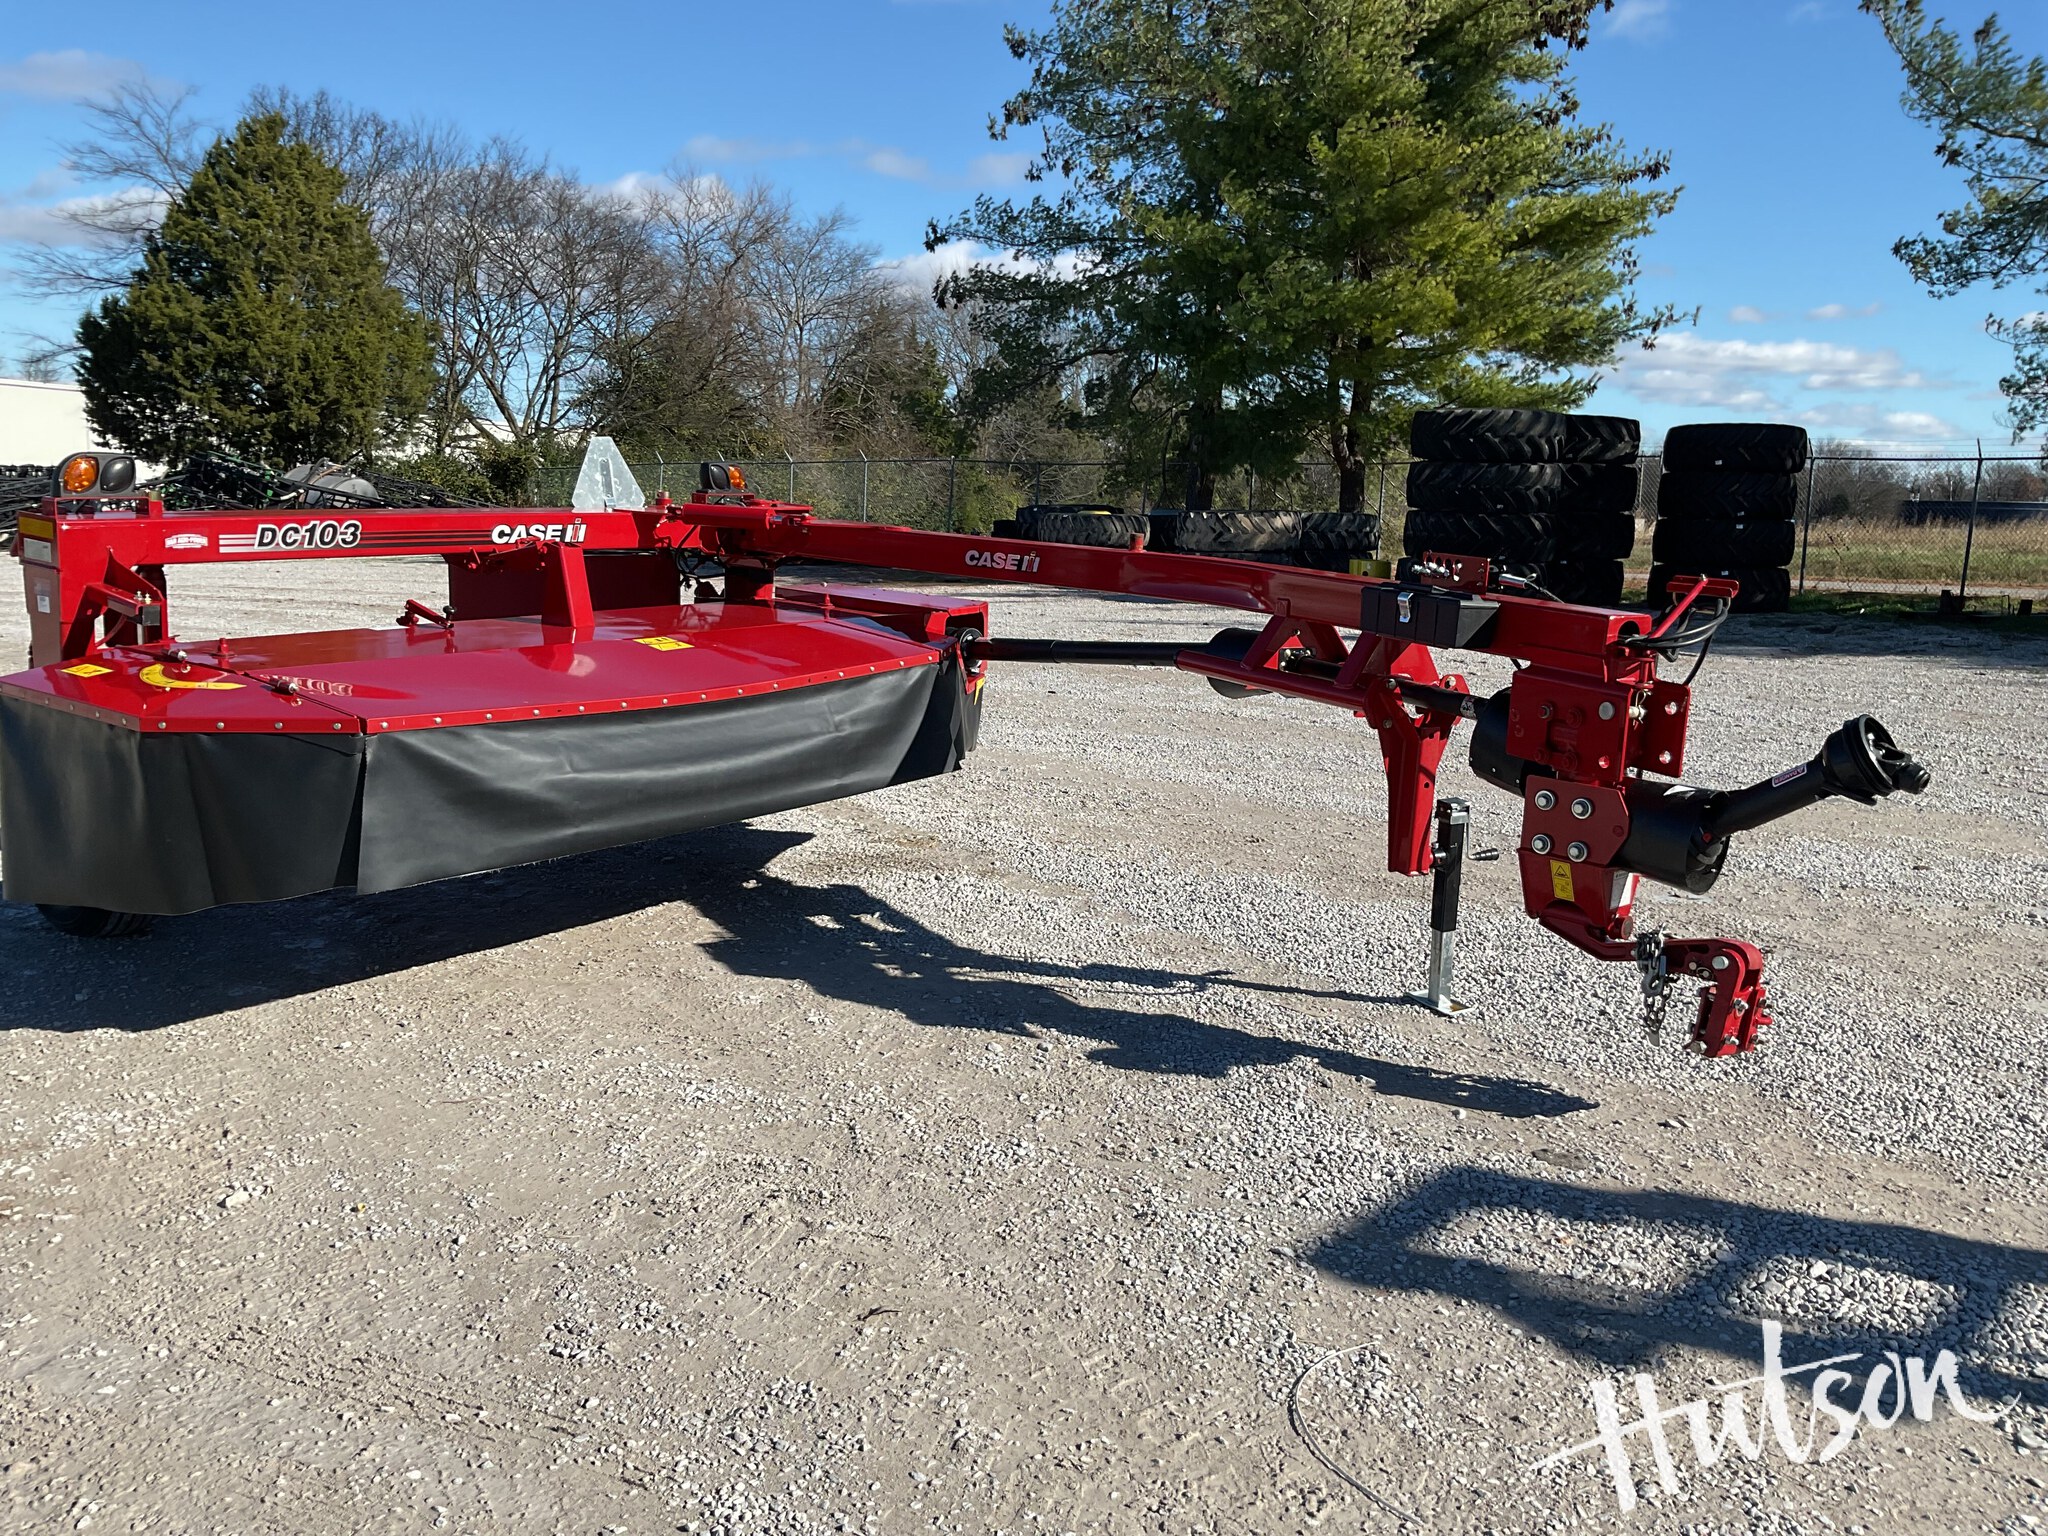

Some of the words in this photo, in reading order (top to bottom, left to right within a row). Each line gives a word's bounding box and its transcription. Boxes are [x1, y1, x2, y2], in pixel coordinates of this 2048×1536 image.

[254, 520, 361, 549] DC103
[491, 524, 563, 544] CASE
[965, 549, 1020, 570] CASE
